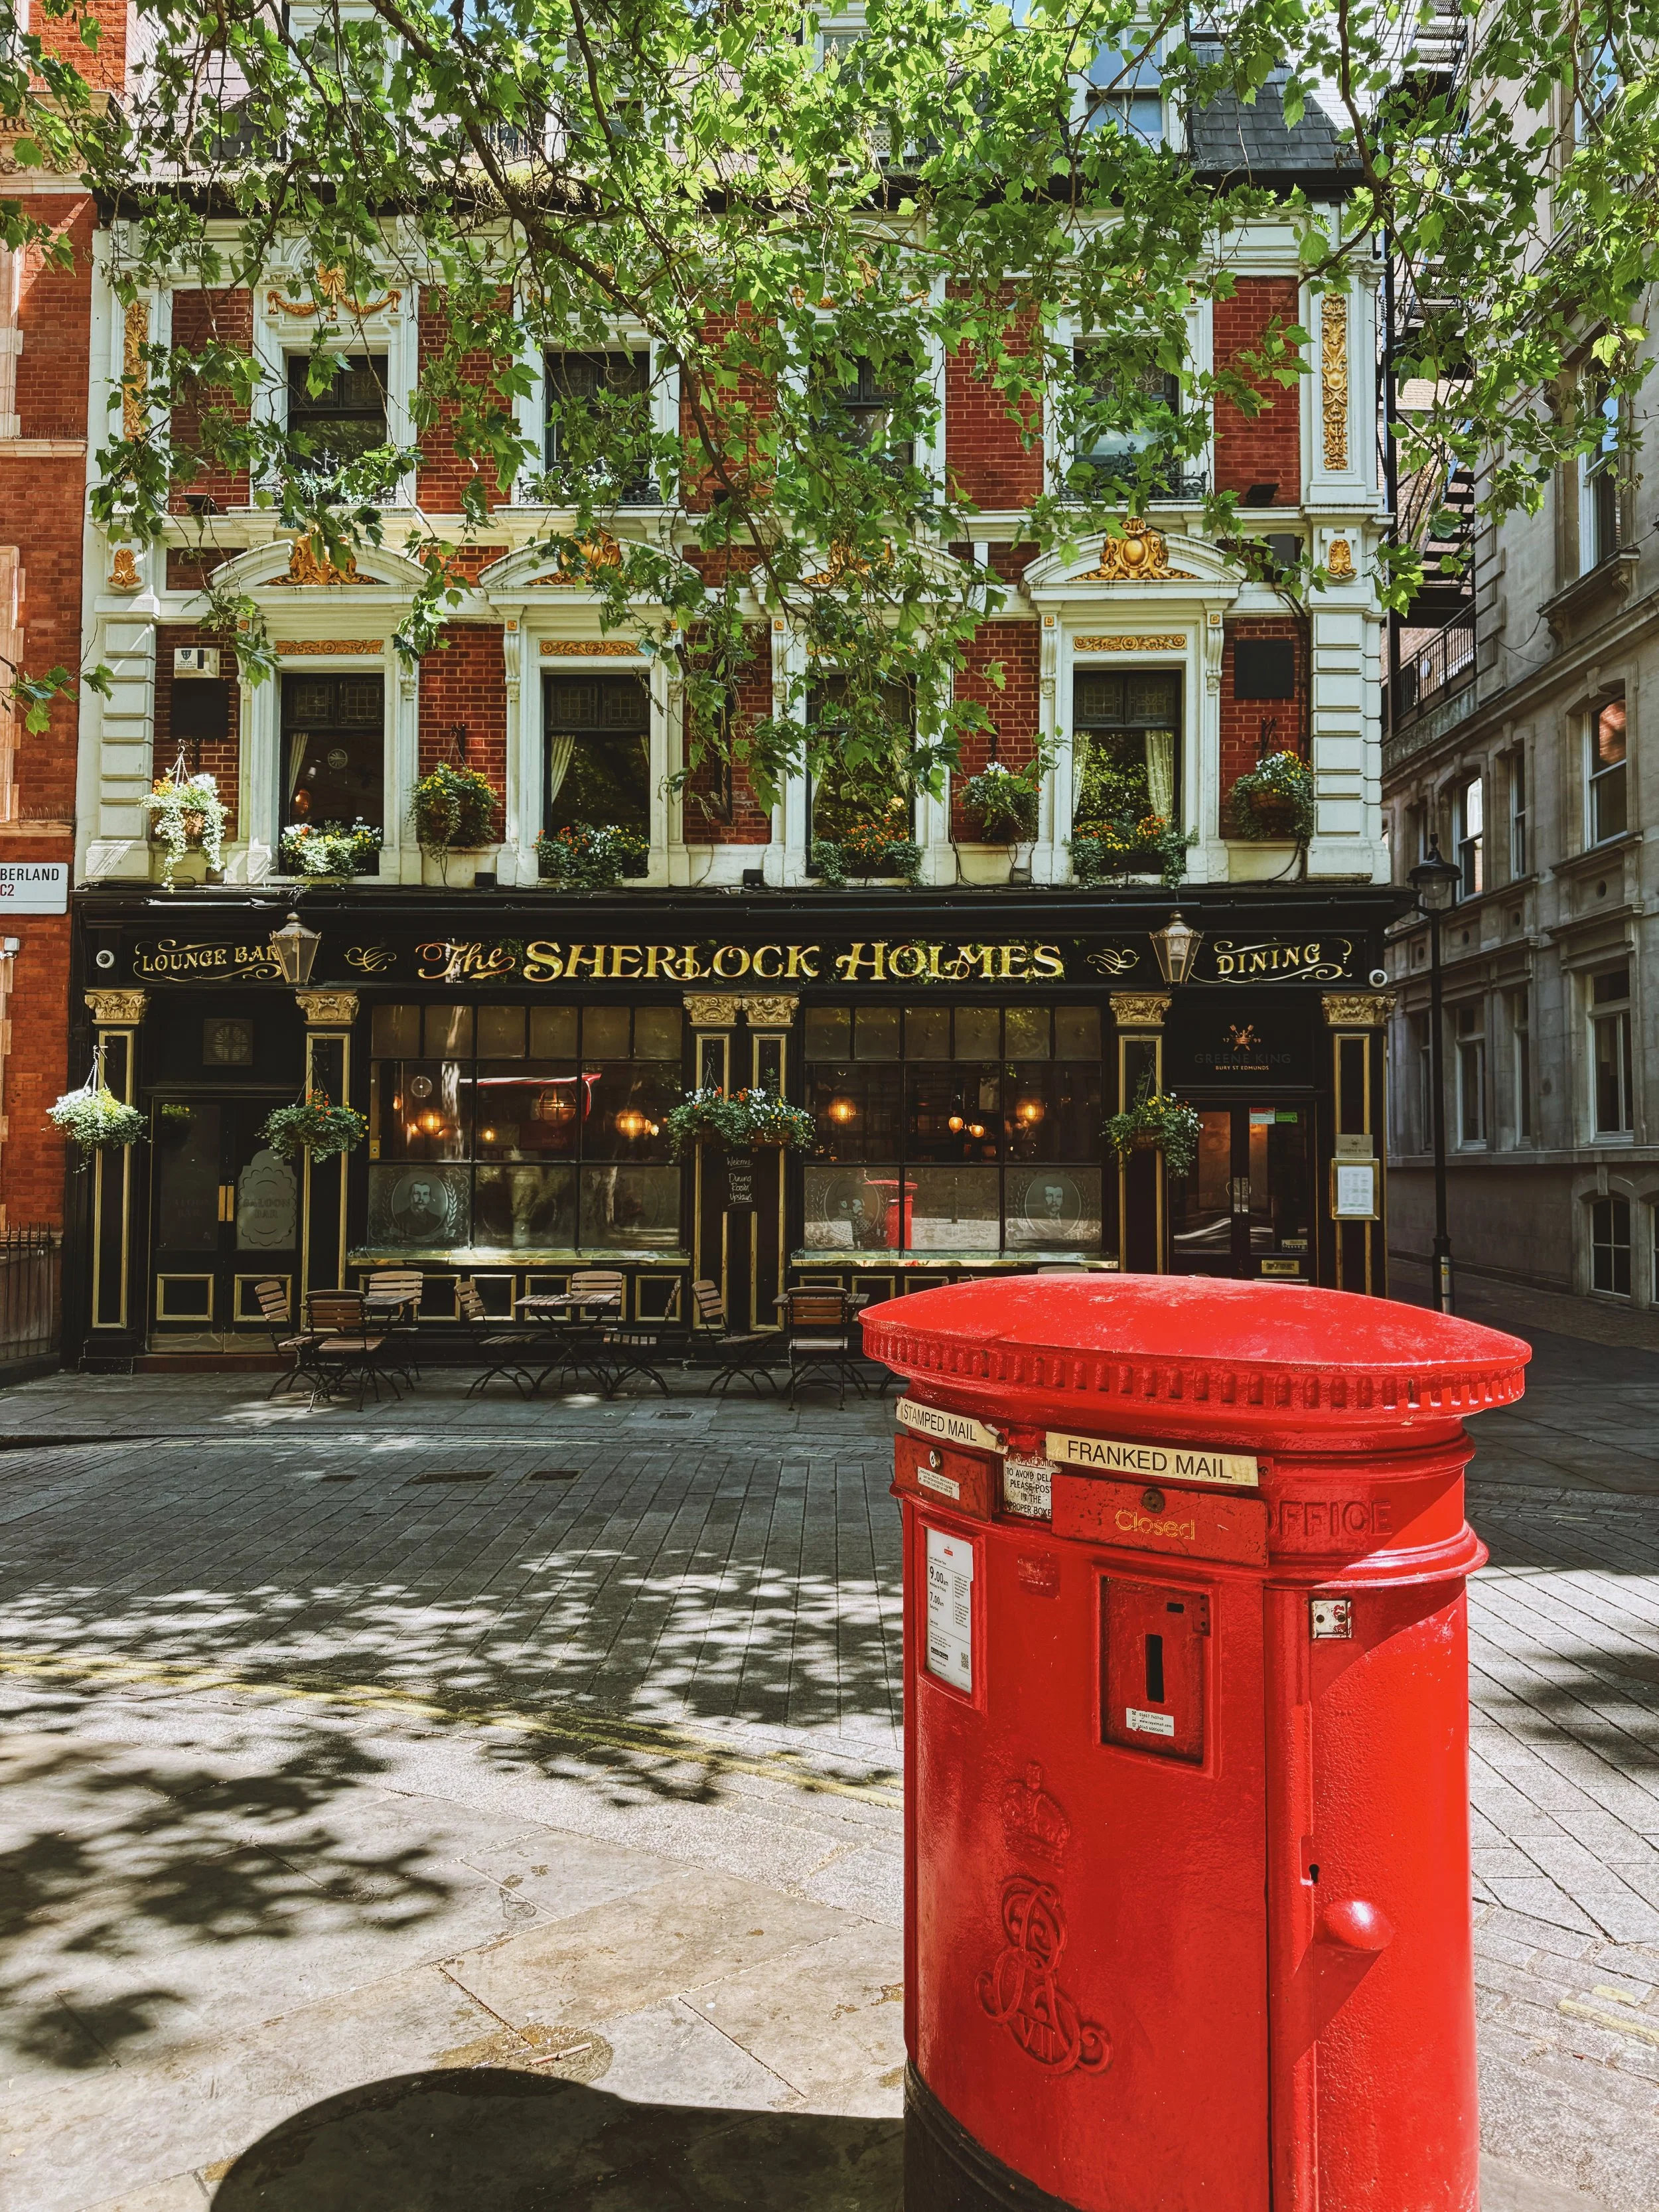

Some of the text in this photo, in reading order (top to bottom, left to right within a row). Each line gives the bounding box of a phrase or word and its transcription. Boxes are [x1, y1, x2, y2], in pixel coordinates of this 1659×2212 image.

[0, 868, 60, 881] BERLAND
[0, 883, 15, 897] C2
[142, 948, 227, 972] LOUNGE
[415, 940, 1064, 982] The SHERLOCK HOLMES
[1216, 943, 1321, 974] DINING
[1194, 1053, 1291, 1063] GREENE KING
[727, 1156, 753, 1166] Welcome
[729, 1173, 751, 1185] Dining
[731, 1183, 749, 1191] Room
[730, 1193, 753, 1202] Upstairs
[254, 1209, 279, 1219] BAR
[903, 1404, 977, 1442] STAMPED MAIL
[1068, 1440, 1232, 1479] FRANKED MAIL
[1007, 1467, 1013, 1476] TO
[1015, 1469, 1035, 1480] AVOID
[1009, 1479, 1033, 1491] PLEASE
[1029, 1494, 1042, 1504] THE
[1009, 1501, 1031, 1514] PROPER
[1115, 1509, 1195, 1540] Closed
[1139, 1720, 1172, 1728] www.royalmail.com
